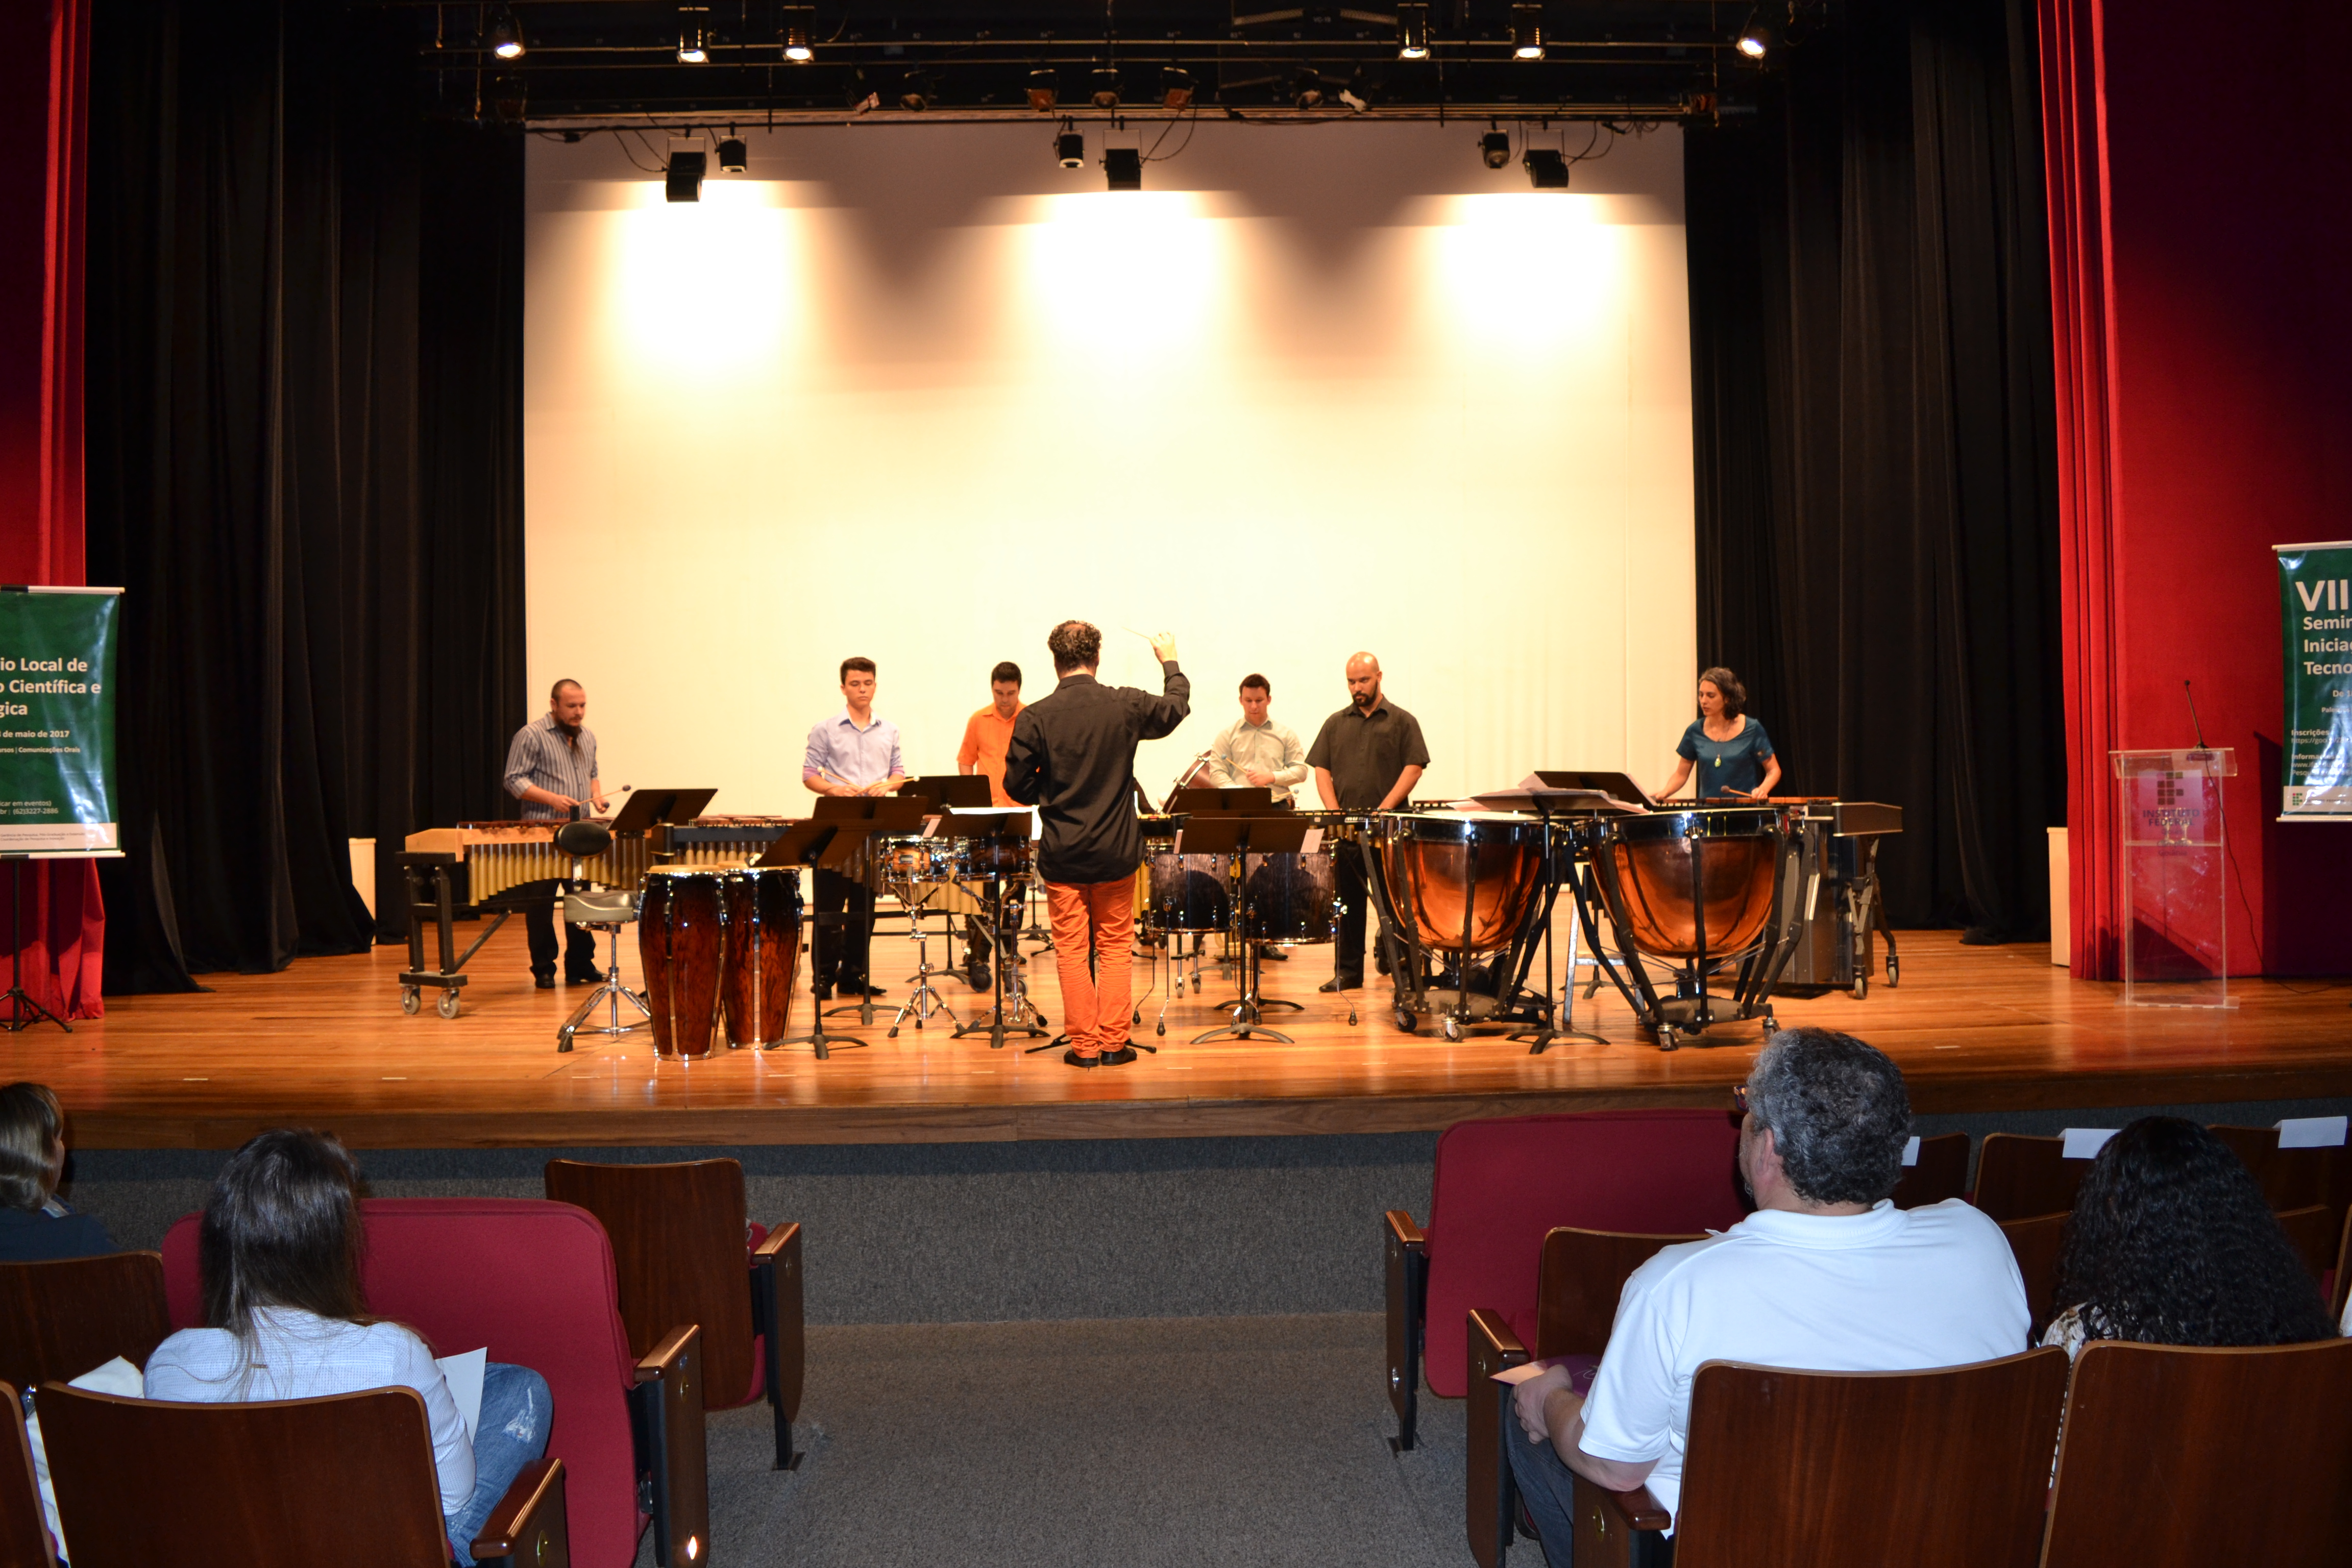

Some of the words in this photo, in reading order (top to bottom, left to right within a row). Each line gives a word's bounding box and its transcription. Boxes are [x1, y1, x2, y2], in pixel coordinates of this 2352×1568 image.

[1, 657, 16, 671] io
[20, 657, 63, 671] Local
[67, 657, 88, 672] de
[9, 679, 87, 694] Científica
[91, 683, 102, 694] e
[2143, 809, 2200, 817] INSTITUTO
[2148, 818, 2194, 826] FEDERAL
